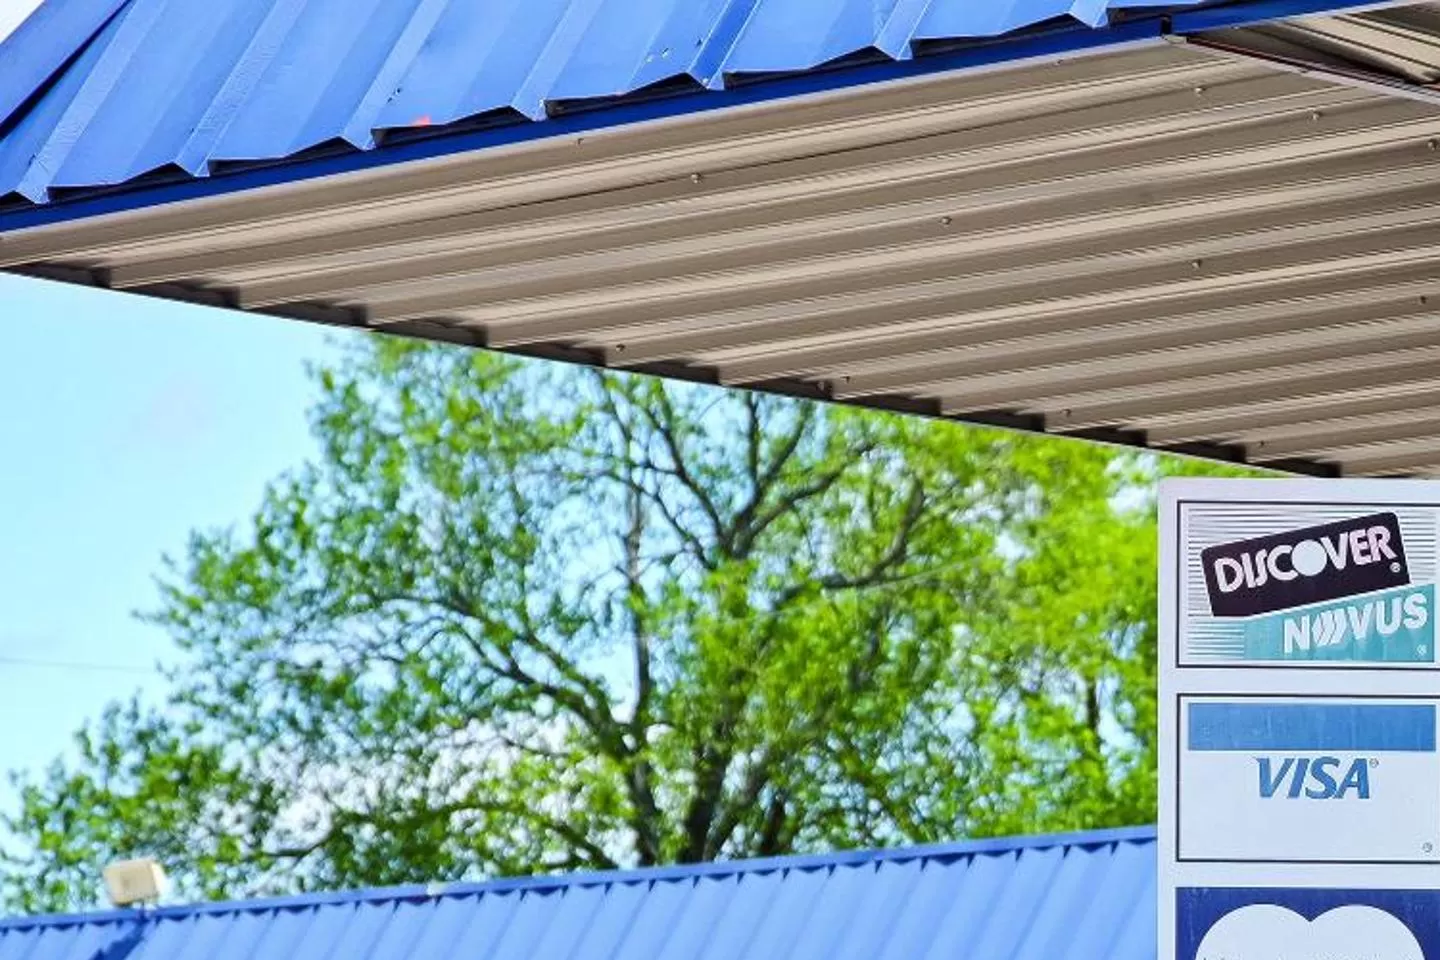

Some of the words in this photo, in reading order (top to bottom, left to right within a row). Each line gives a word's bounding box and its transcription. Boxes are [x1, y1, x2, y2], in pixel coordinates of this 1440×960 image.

[1213, 525, 1397, 593] DISCOVER
[1283, 592, 1429, 654] NOVUS
[1256, 756, 1370, 799] VISA
